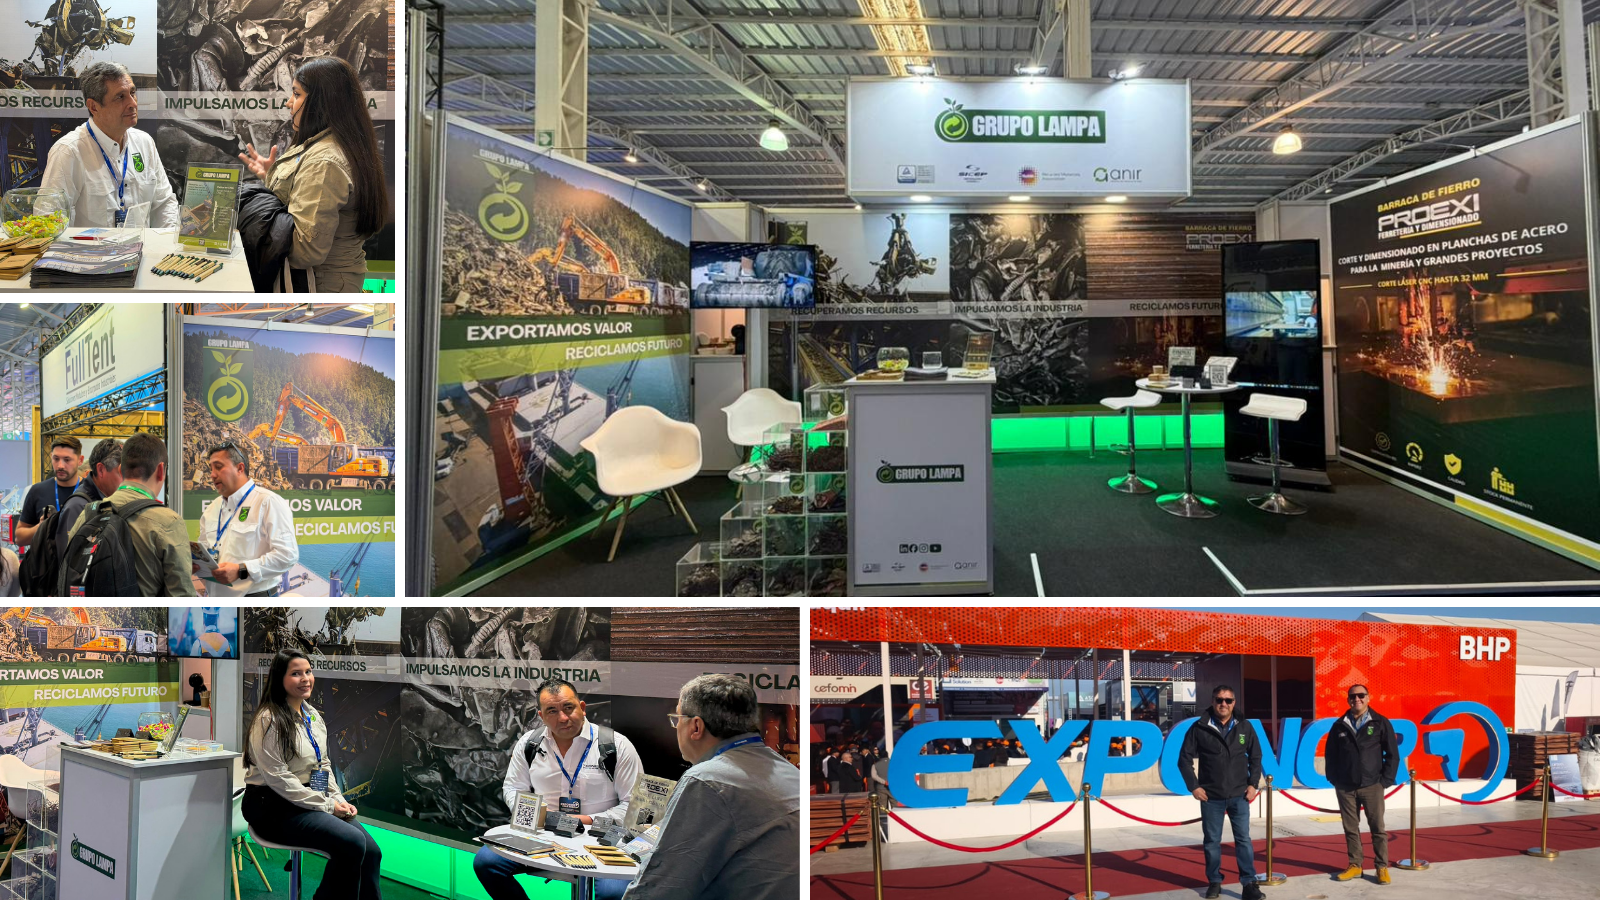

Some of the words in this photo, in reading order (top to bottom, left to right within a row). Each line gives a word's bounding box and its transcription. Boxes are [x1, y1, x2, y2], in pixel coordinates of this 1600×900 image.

[23, 96, 87, 108] RECURS
[165, 97, 269, 110] IMPULSAMOS
[272, 98, 289, 110] LA
[972, 115, 1034, 136] GRUPO
[1038, 115, 1101, 137] LAMPA
[480, 149, 505, 164] GRUPO
[506, 156, 530, 171] LAMPA
[1109, 168, 1143, 180] anir
[1378, 194, 1420, 213] BARRACA
[1421, 190, 1436, 201] DE
[1438, 177, 1481, 197] FIERRO
[1378, 193, 1480, 232] PROEXI
[1378, 226, 1415, 240] FERRETERIA
[1415, 225, 1420, 233] Y
[1421, 212, 1479, 231] DIMENSIONADO
[1186, 233, 1252, 244] PROEXI
[1338, 255, 1358, 265] CORTE
[1364, 245, 1425, 262] DIMENSIONADO
[1427, 243, 1440, 252] EN
[1442, 233, 1499, 251] PLANCHAS
[1501, 230, 1518, 242] DE
[1520, 222, 1568, 239] ACERO
[1350, 264, 1368, 275] PARA
[1368, 264, 1378, 273] LA
[1380, 257, 1415, 271] MINERÍA
[1415, 258, 1421, 267] Y
[1423, 252, 1469, 266] GRANDES
[1471, 243, 1544, 261] PROYECTOS
[1377, 280, 1397, 288] CORTE
[1397, 276, 1417, 286] LÁSER
[1418, 277, 1433, 285] CNC
[1434, 275, 1459, 285] HASTA
[1460, 274, 1471, 282] 32
[1472, 272, 1489, 281] MM
[792, 306, 865, 315] RECUPERAMOS
[866, 305, 919, 314] RECURSOS
[954, 304, 1019, 313] IMPULSAMOS
[1020, 304, 1032, 313] LA
[1033, 304, 1083, 312] INDUSTRIA
[1129, 302, 1190, 311] RECICLAMOS
[1191, 302, 1222, 310] FUTUR
[466, 322, 592, 341] EXPORTAMOS
[593, 321, 633, 335] VALOR
[208, 338, 228, 347] GRUPO
[229, 340, 250, 349] LAMPA
[565, 341, 646, 361] RECICLAMOS
[647, 338, 683, 351] FUTURO
[895, 468, 927, 480] GRUPO
[928, 467, 962, 479] LAMPA
[314, 498, 362, 512] VALOR
[293, 522, 381, 536] ECICLAMOS
[1460, 634, 1511, 661] BHP
[316, 659, 367, 672] RECURSOS
[62, 668, 104, 679] VALOR
[406, 663, 491, 678] IMPULSAMOS
[493, 666, 511, 679] LA
[514, 666, 602, 683] INDUSTRIA
[34, 686, 120, 700] RECICLAMOS
[122, 685, 168, 697] FUTURO
[814, 682, 857, 693] cefomin
[80, 846, 96, 865] GRUPO
[95, 854, 114, 875] LAMPA
